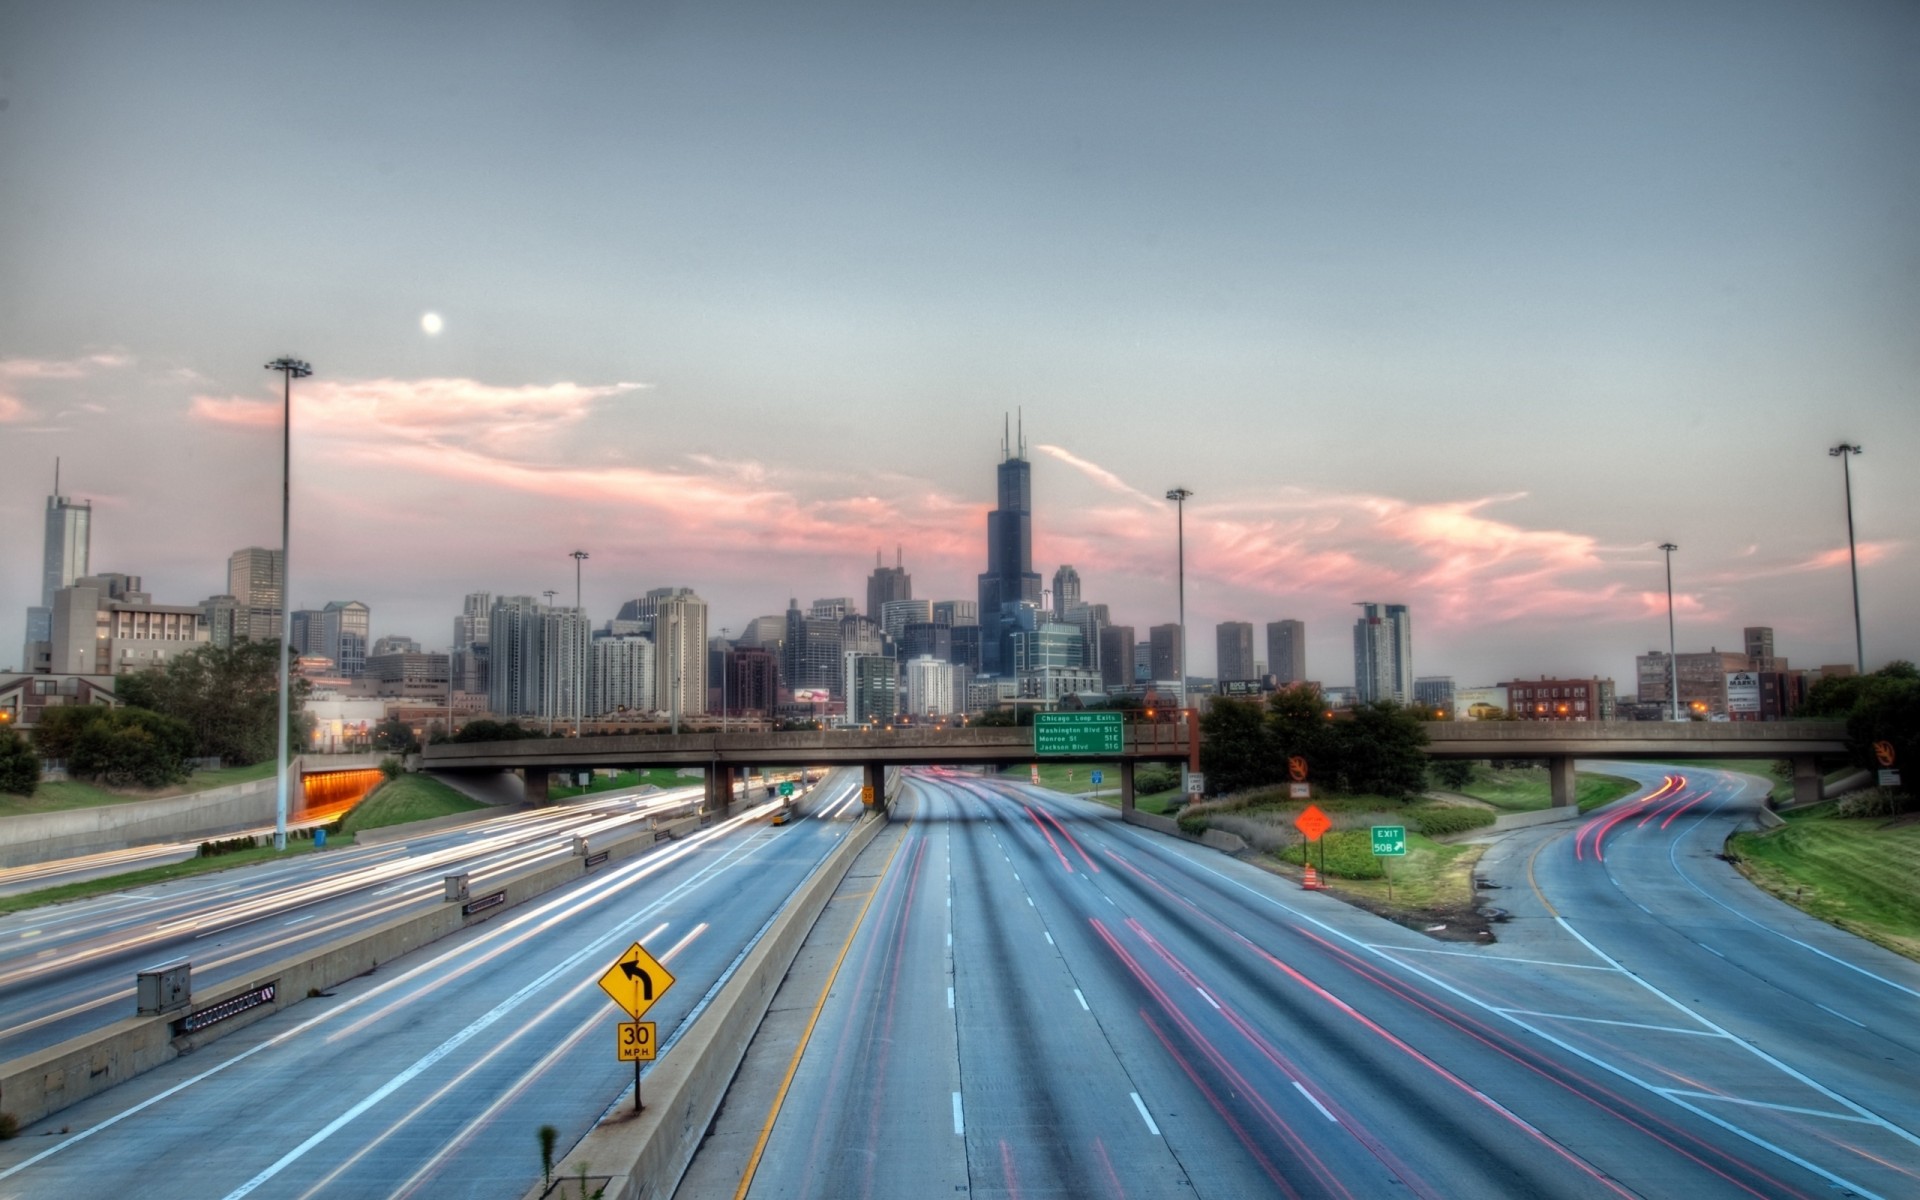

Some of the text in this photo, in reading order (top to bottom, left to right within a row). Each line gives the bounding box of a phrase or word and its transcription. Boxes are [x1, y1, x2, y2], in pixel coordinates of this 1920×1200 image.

[1041, 715, 1070, 723] Chicago
[1377, 830, 1399, 838] EXIT
[1374, 843, 1393, 852] 50B
[623, 1026, 649, 1045] 30
